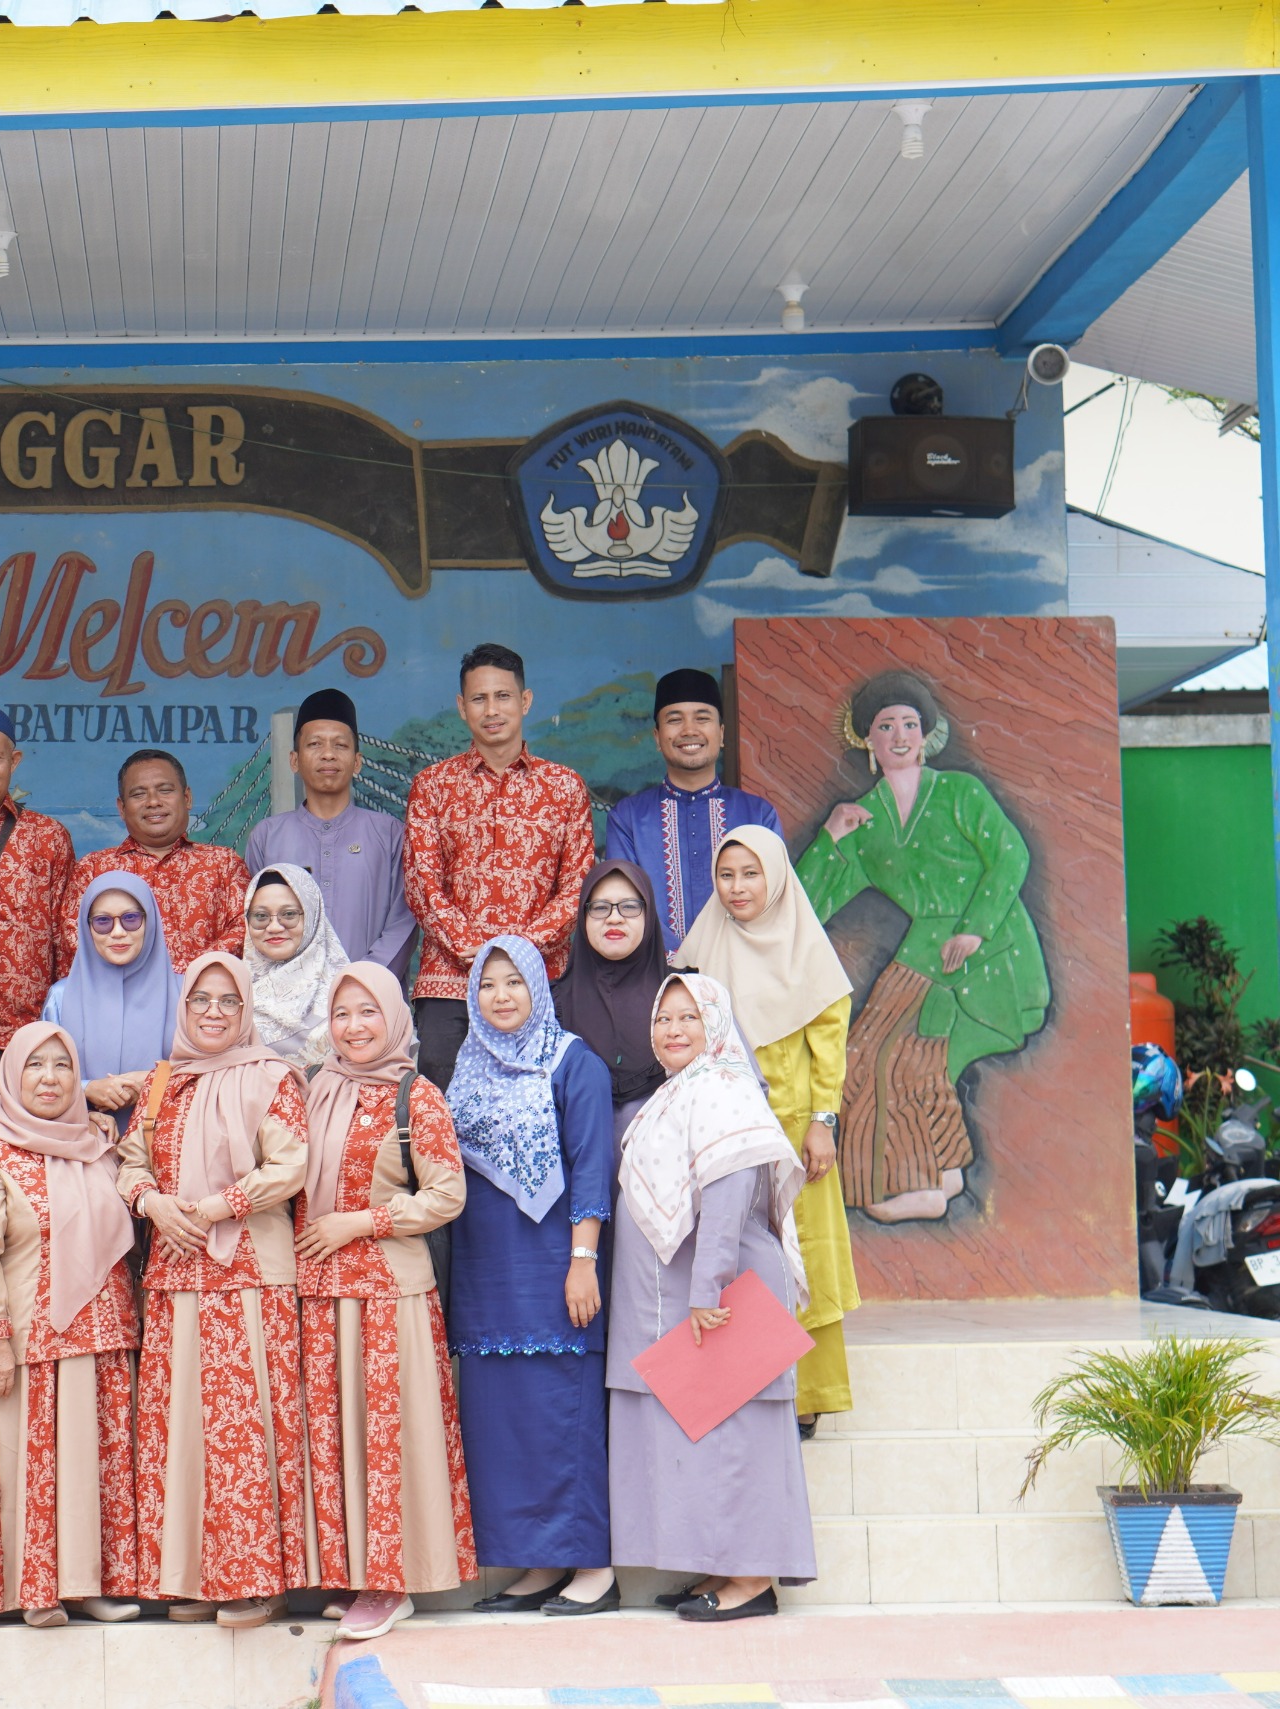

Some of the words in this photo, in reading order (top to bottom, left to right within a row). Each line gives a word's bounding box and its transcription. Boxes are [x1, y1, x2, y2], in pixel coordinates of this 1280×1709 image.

[546, 442, 575, 471] TUT
[573, 422, 613, 449] WURI
[615, 420, 695, 472] HANDAYANI
[3, 704, 260, 743] BATUAMPAR
